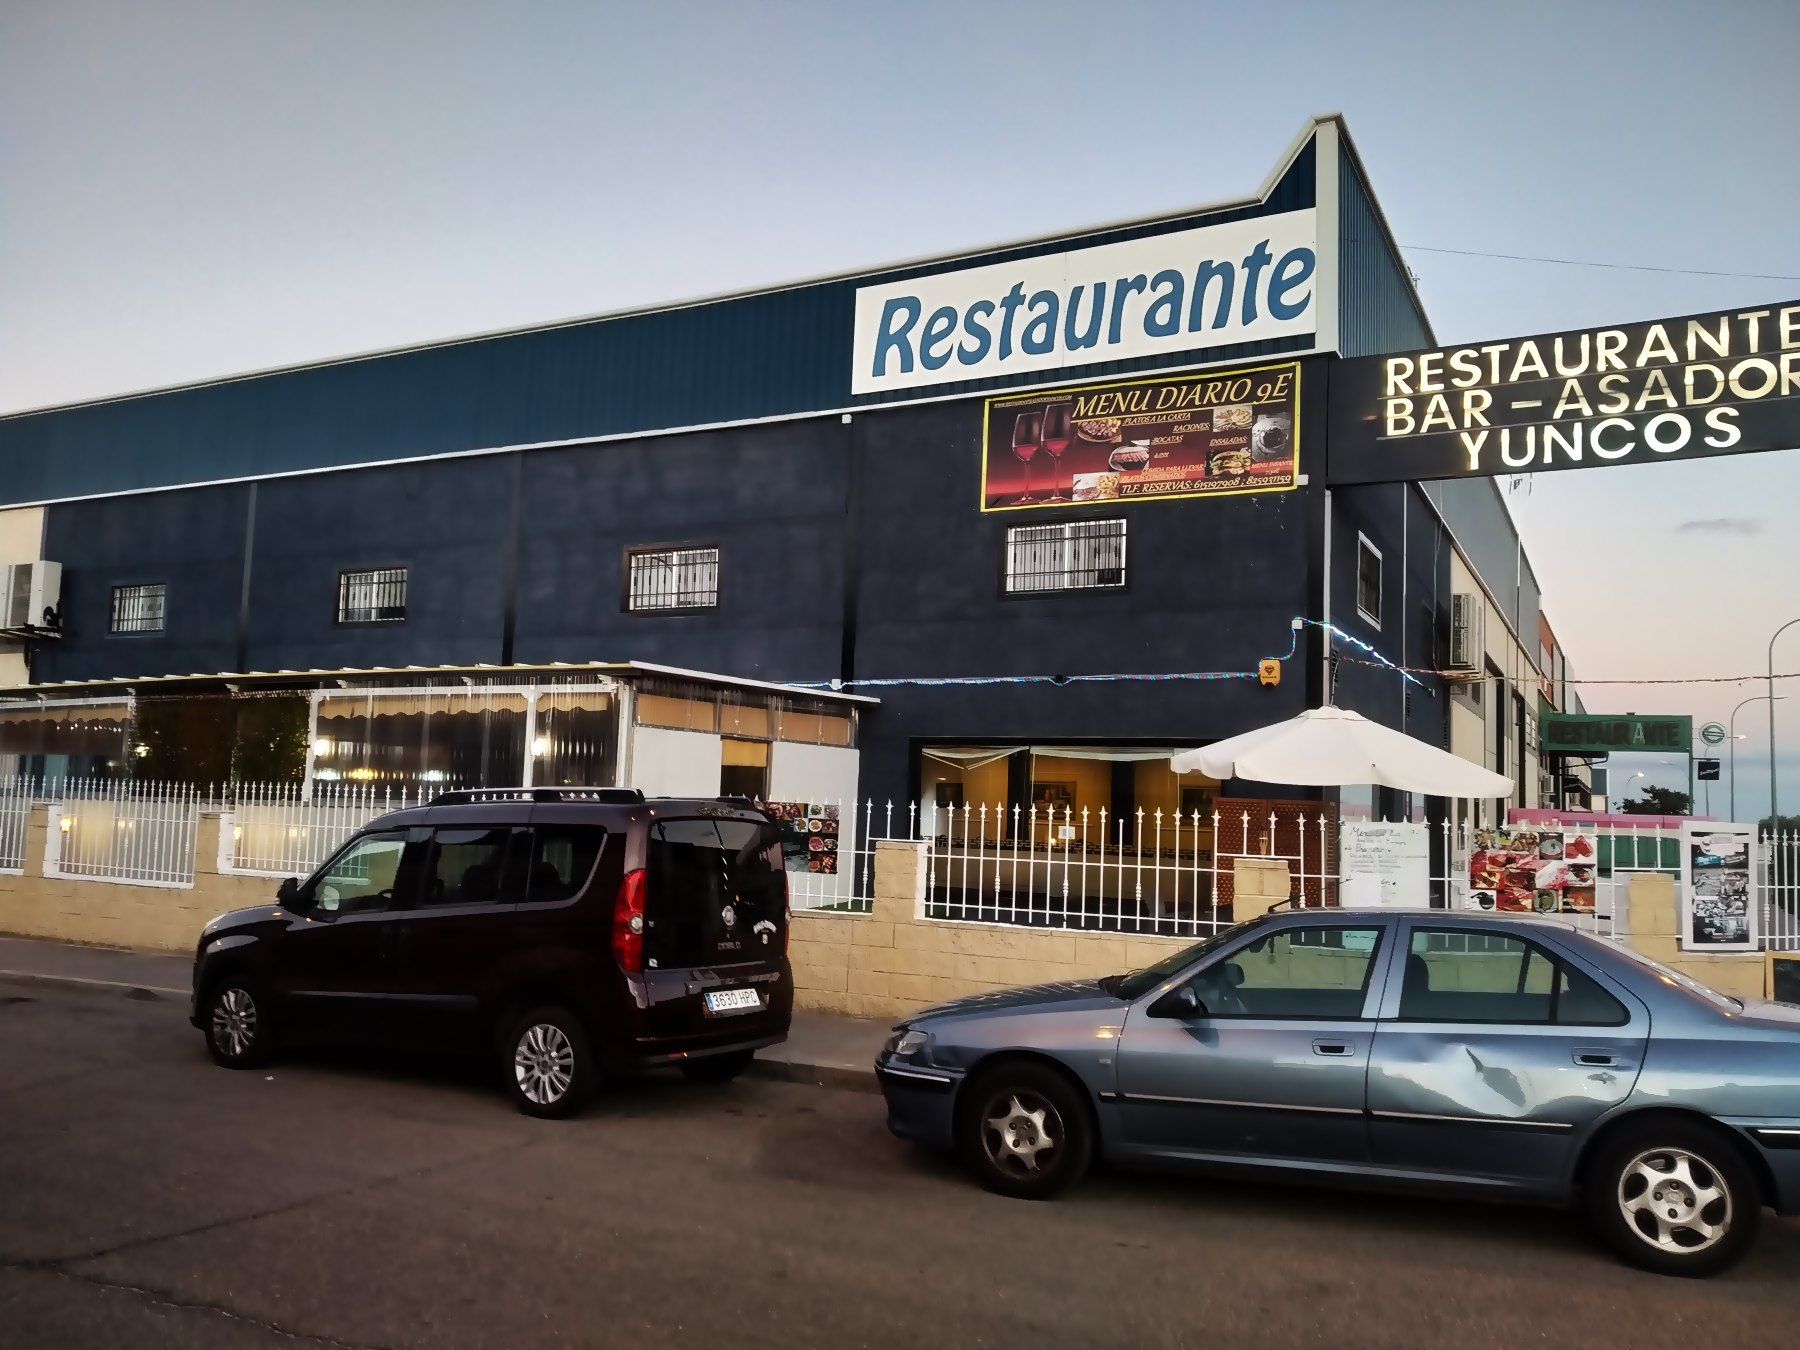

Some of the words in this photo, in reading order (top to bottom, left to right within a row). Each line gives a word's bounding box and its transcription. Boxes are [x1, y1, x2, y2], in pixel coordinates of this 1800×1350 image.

[872, 239, 1316, 377] Restaurante
[1386, 306, 1800, 397] RESTAURANTE
[1072, 389, 1152, 418] MENU
[1156, 379, 1252, 410] DIARIO
[1167, 412, 1191, 421] CARTA
[1386, 389, 1494, 437] BAR
[1460, 406, 1742, 471] YUNCOS
[1548, 721, 1680, 746] RESTAURANTE
[713, 992, 739, 1008] 3630
[739, 990, 758, 1005] HPC
